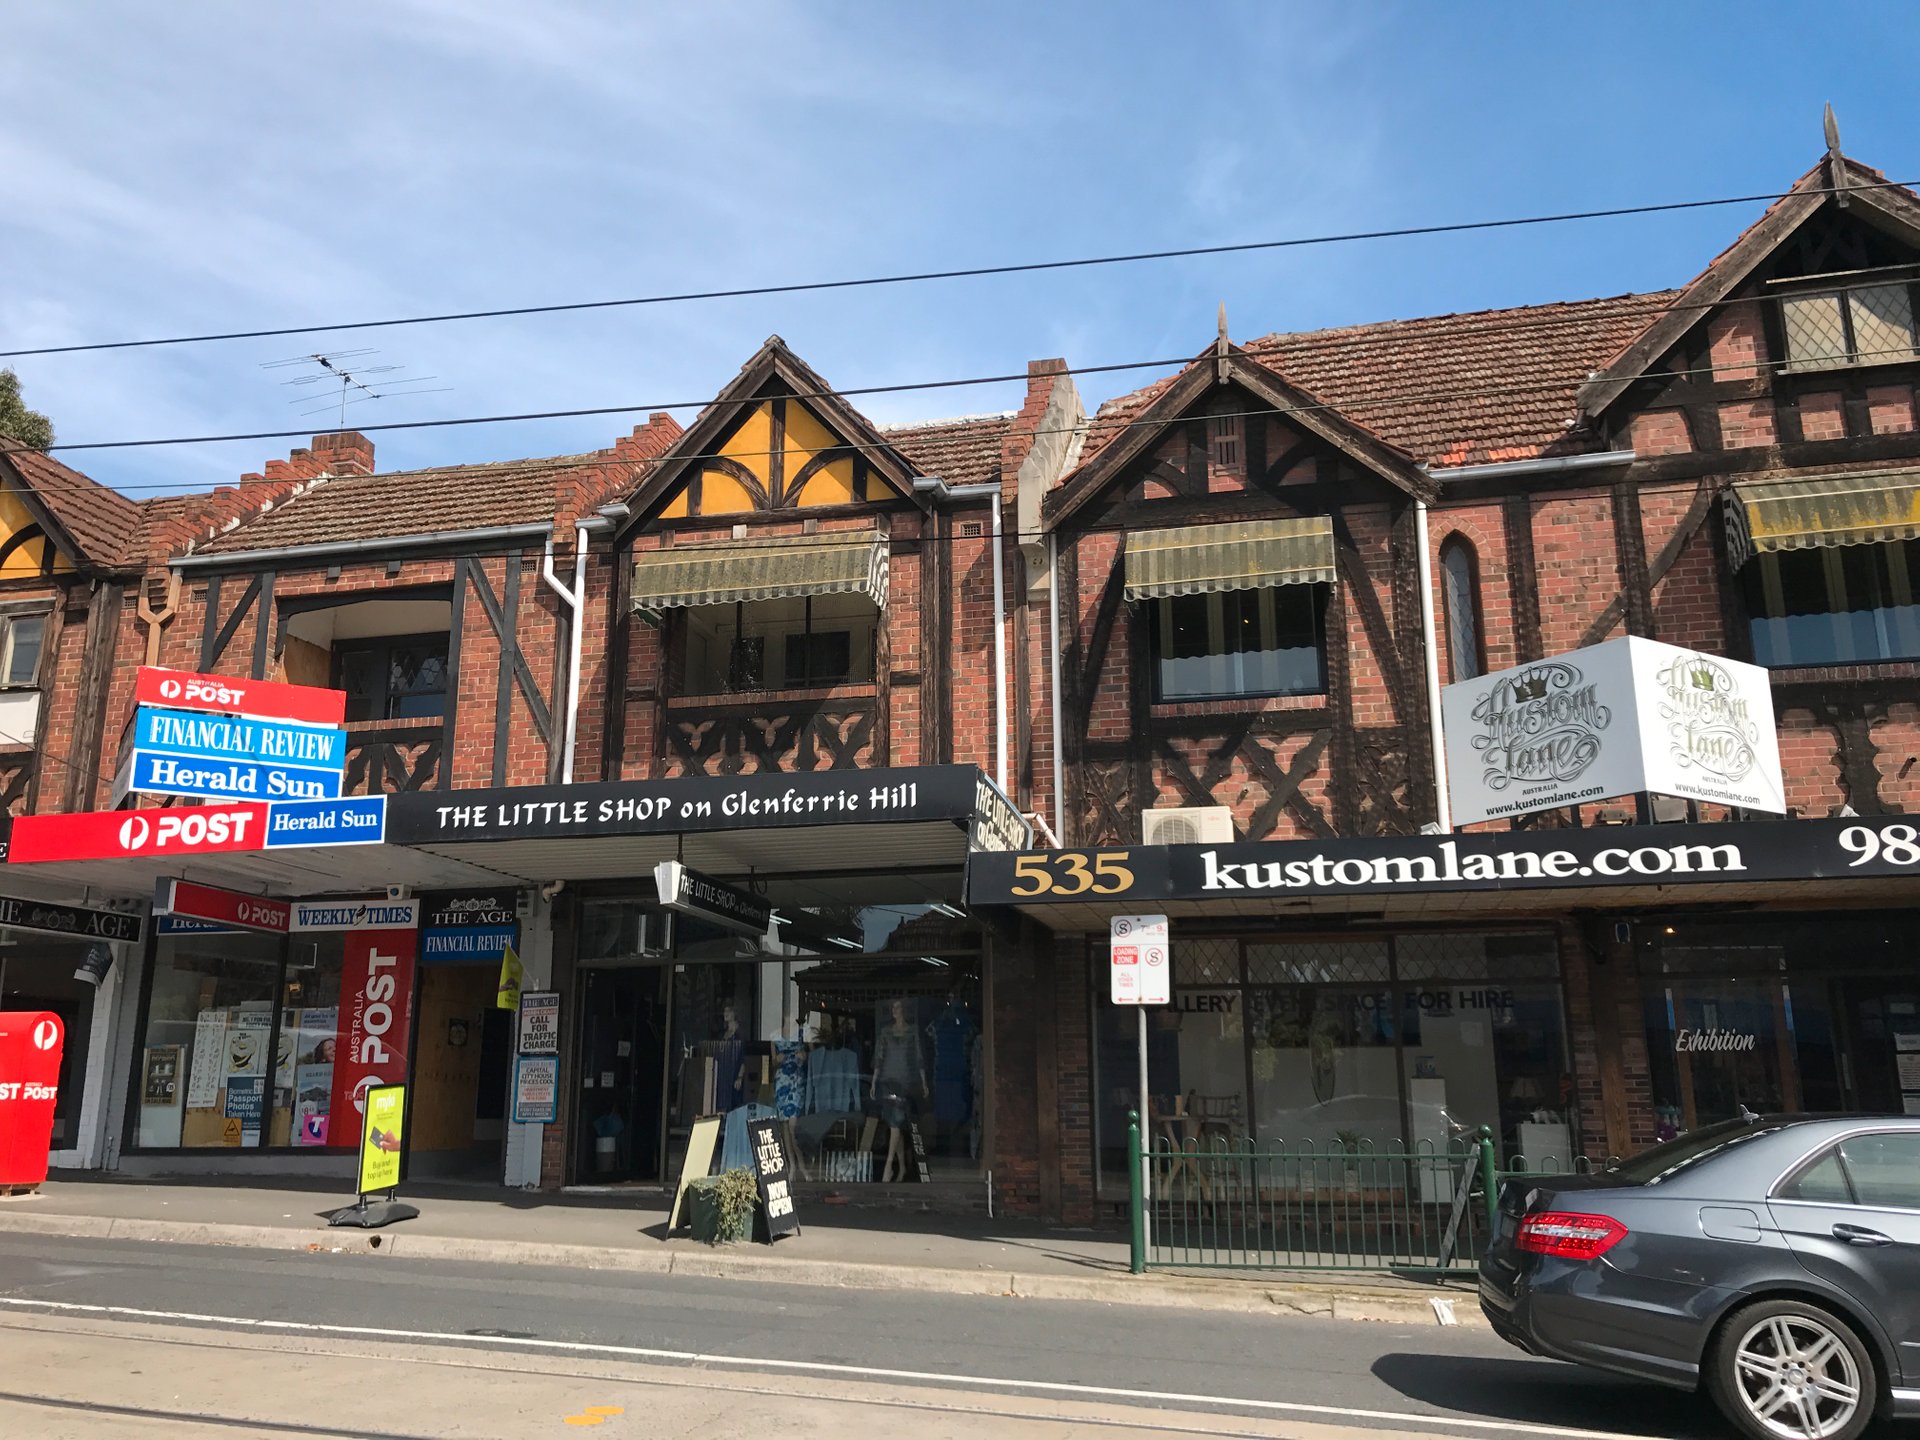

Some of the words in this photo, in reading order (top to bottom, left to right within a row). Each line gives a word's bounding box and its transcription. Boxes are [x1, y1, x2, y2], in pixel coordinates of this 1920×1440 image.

[187, 679, 225, 688] AUSTRALIA
[184, 685, 246, 706] POST
[149, 715, 255, 753] FINANCIAL
[259, 728, 335, 761] REVIEW
[148, 759, 258, 793] Herald
[266, 770, 326, 798] Sun
[975, 780, 993, 817] THE
[1522, 783, 1558, 796] AUSTRALIA
[1674, 782, 1761, 805] www.kustomlane.com
[435, 805, 489, 829] THE
[498, 800, 589, 826] LITTLE
[598, 797, 672, 822] SHOP
[680, 800, 712, 818] on
[721, 788, 859, 816] Glenferrie
[868, 782, 917, 810] Hill
[1485, 784, 1604, 816] www.kustomlane.com
[156, 811, 254, 847] POST
[273, 812, 335, 832] Herald
[340, 810, 378, 829] Sun
[1011, 851, 1135, 896] 535
[1201, 841, 1747, 890] kustomlane.com
[680, 874, 694, 895] THE
[695, 881, 715, 903] LITTLE
[715, 889, 736, 910] SHOP
[84, 911, 132, 938] AGE
[251, 906, 286, 928] POST
[298, 908, 357, 926] WEEKLY
[367, 906, 412, 924] TIMES
[431, 911, 469, 925] THE
[475, 910, 513, 924] AGE
[426, 935, 475, 953] FINANCIAL
[477, 934, 515, 952] REVIEW
[1113, 947, 1138, 956] LOADING
[1116, 955, 1134, 964] ZONE
[361, 947, 397, 1064] POST
[1166, 994, 1238, 1014] LLERY
[1405, 991, 1453, 1011] FOR
[1459, 989, 1515, 1010] HIRE
[349, 990, 364, 1064] AUSTRALIA
[530, 1015, 550, 1024] CALL
[531, 1024, 548, 1032] FOR
[523, 1032, 557, 1041] TRAFFIC
[523, 1040, 556, 1049] CHARGE
[1675, 1028, 1755, 1052] Exhibition
[23, 1086, 58, 1100] POST
[228, 1094, 263, 1103] Passport
[227, 1102, 254, 1110] Photos
[227, 1110, 245, 1118] Taken
[246, 1110, 261, 1118] Here
[758, 1128, 775, 1145] THE
[757, 1142, 782, 1161] LITTLE
[367, 1171, 377, 1180] top
[760, 1157, 784, 1175] SHOP
[766, 1180, 788, 1200] NOW
[768, 1196, 794, 1218] OPEN
